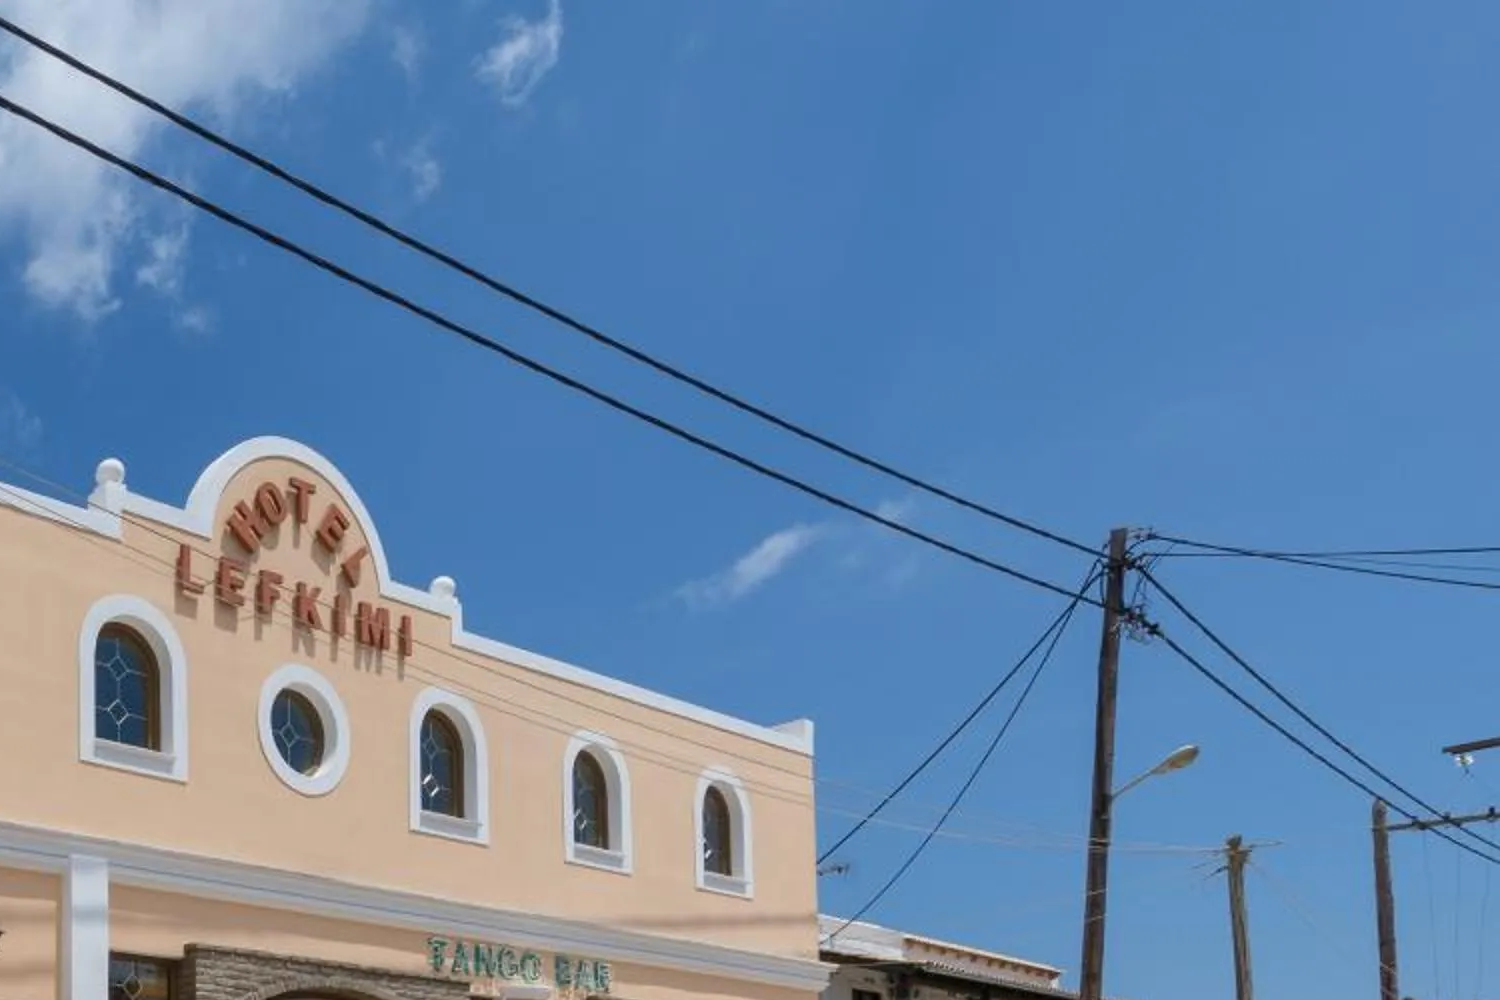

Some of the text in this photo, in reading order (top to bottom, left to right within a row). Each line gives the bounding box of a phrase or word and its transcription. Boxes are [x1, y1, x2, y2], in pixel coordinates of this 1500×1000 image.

[225, 476, 369, 588] HOTEL
[176, 543, 413, 657] LEFKIMI
[428, 936, 542, 982] TANGO
